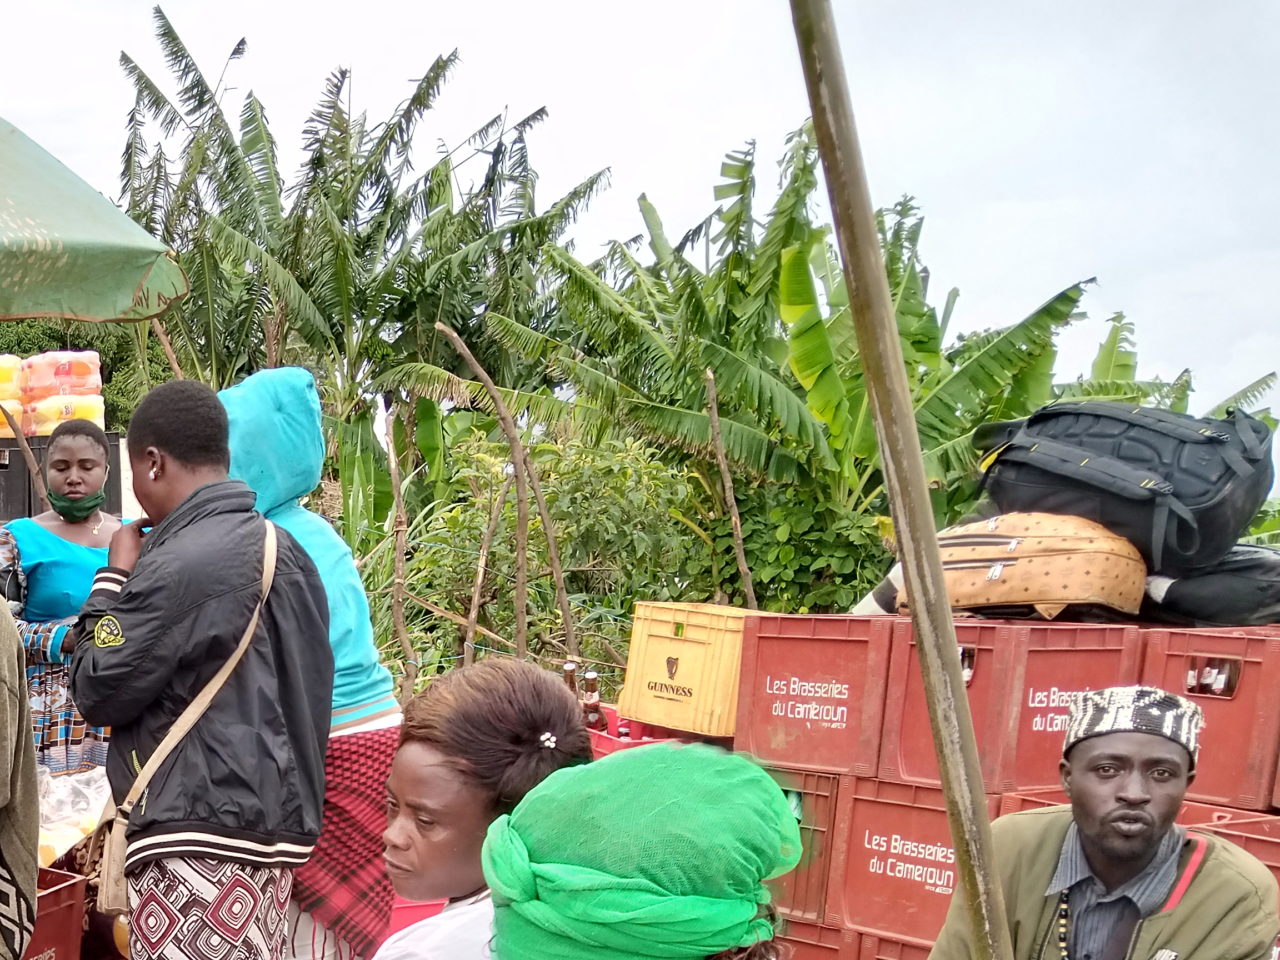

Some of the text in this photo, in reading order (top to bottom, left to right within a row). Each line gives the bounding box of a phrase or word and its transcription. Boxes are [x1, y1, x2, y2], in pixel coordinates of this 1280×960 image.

[647, 680, 694, 698] GUINNESS
[766, 675, 849, 699] Les Brasseries
[1028, 687, 1048, 707] Les
[772, 700, 847, 722] du Cameroun
[1032, 713, 1046, 731] du
[864, 829, 955, 864] Les Brasseries
[869, 855, 954, 888] du Cameroun
